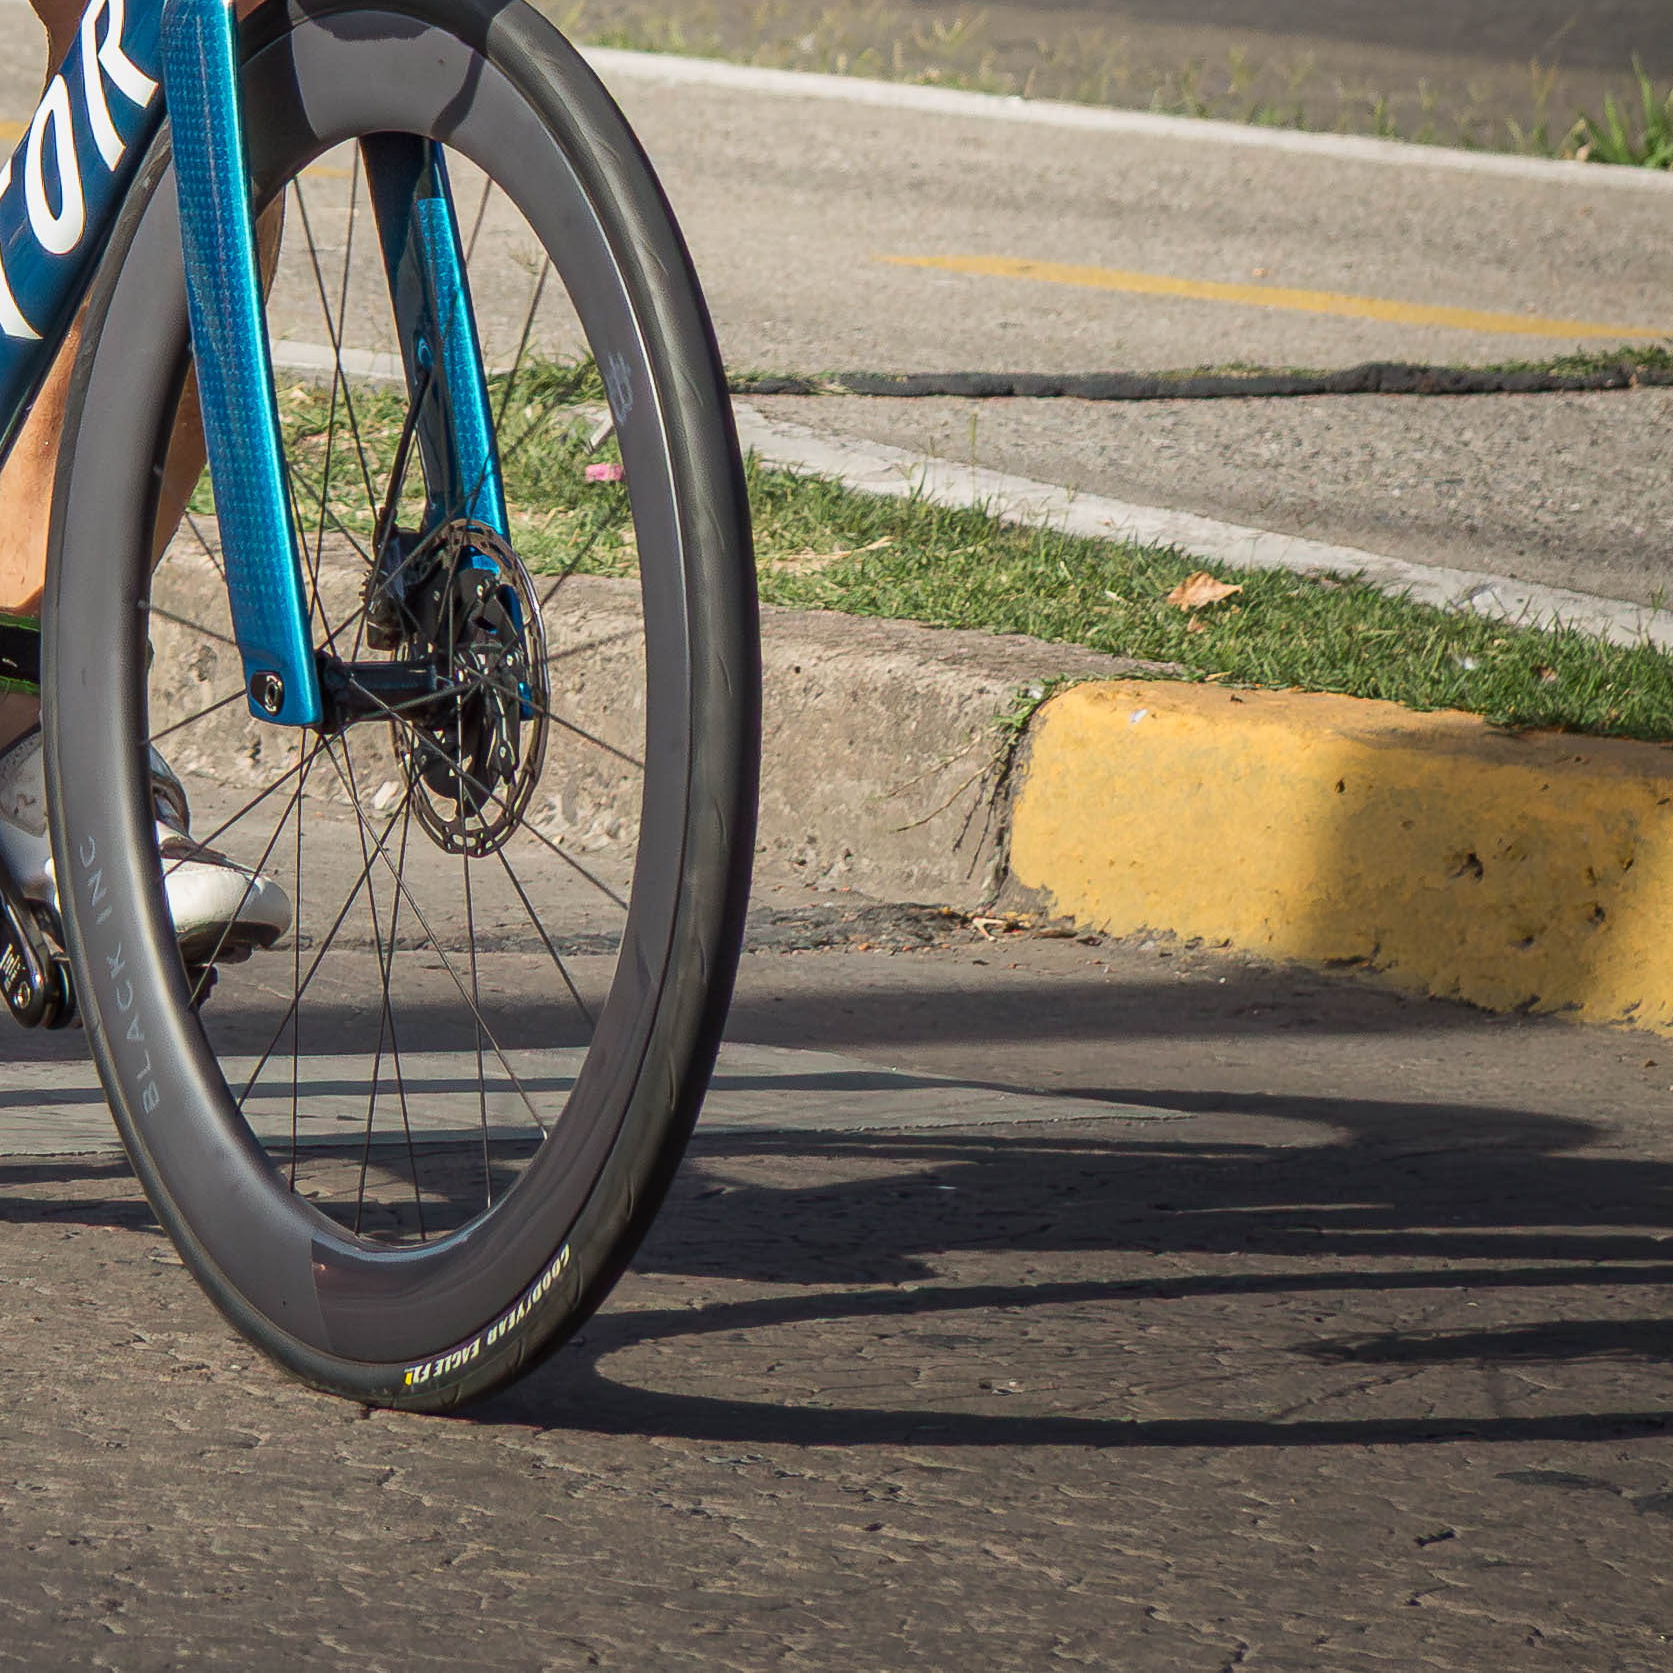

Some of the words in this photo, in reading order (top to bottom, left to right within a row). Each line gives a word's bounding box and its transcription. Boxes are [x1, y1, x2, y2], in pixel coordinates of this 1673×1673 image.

[80, 835, 113, 925] INC
[106, 942, 160, 1115] BLACK
[487, 1243, 570, 1346] GOODYEAR
[433, 1338, 480, 1377] EAGLE
